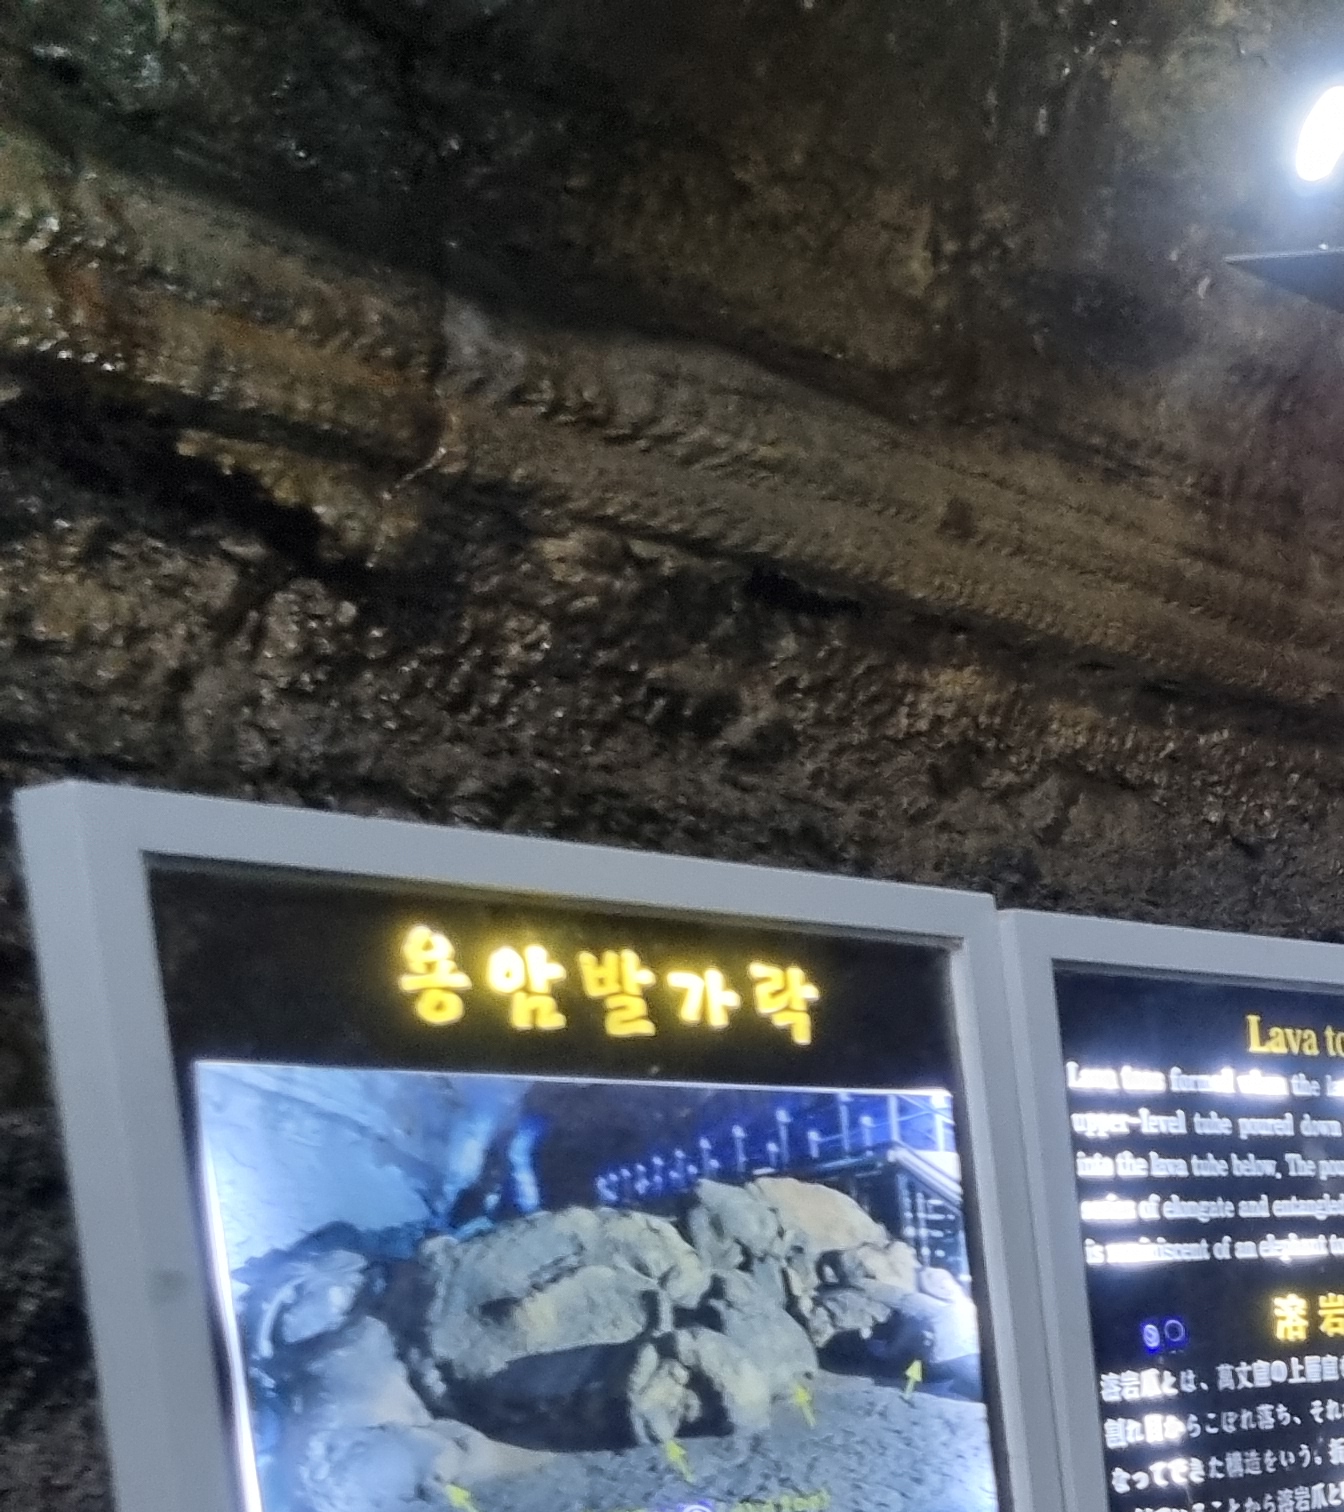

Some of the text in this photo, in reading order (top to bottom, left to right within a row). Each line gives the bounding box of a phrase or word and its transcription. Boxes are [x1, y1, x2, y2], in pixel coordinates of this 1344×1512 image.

[399, 925, 820, 1045] 용암발가락
[1246, 1014, 1319, 1056] Lava
[1070, 1107, 1187, 1139] upper-level
[1194, 1110, 1233, 1136] tube
[1238, 1112, 1295, 1140] poured
[1300, 1113, 1342, 1137] down
[1076, 1150, 1115, 1179] into
[1116, 1150, 1149, 1179] the
[1149, 1150, 1189, 1178] lava
[1190, 1152, 1230, 1177] tube
[1285, 1153, 1316, 1177] The
[1162, 1193, 1235, 1223] elongate
[1238, 1194, 1271, 1218] and
[1085, 1238, 1105, 1265] is
[1105, 1236, 1211, 1265] iiscent
[1213, 1235, 1232, 1260] of
[1234, 1240, 1259, 1260] an
